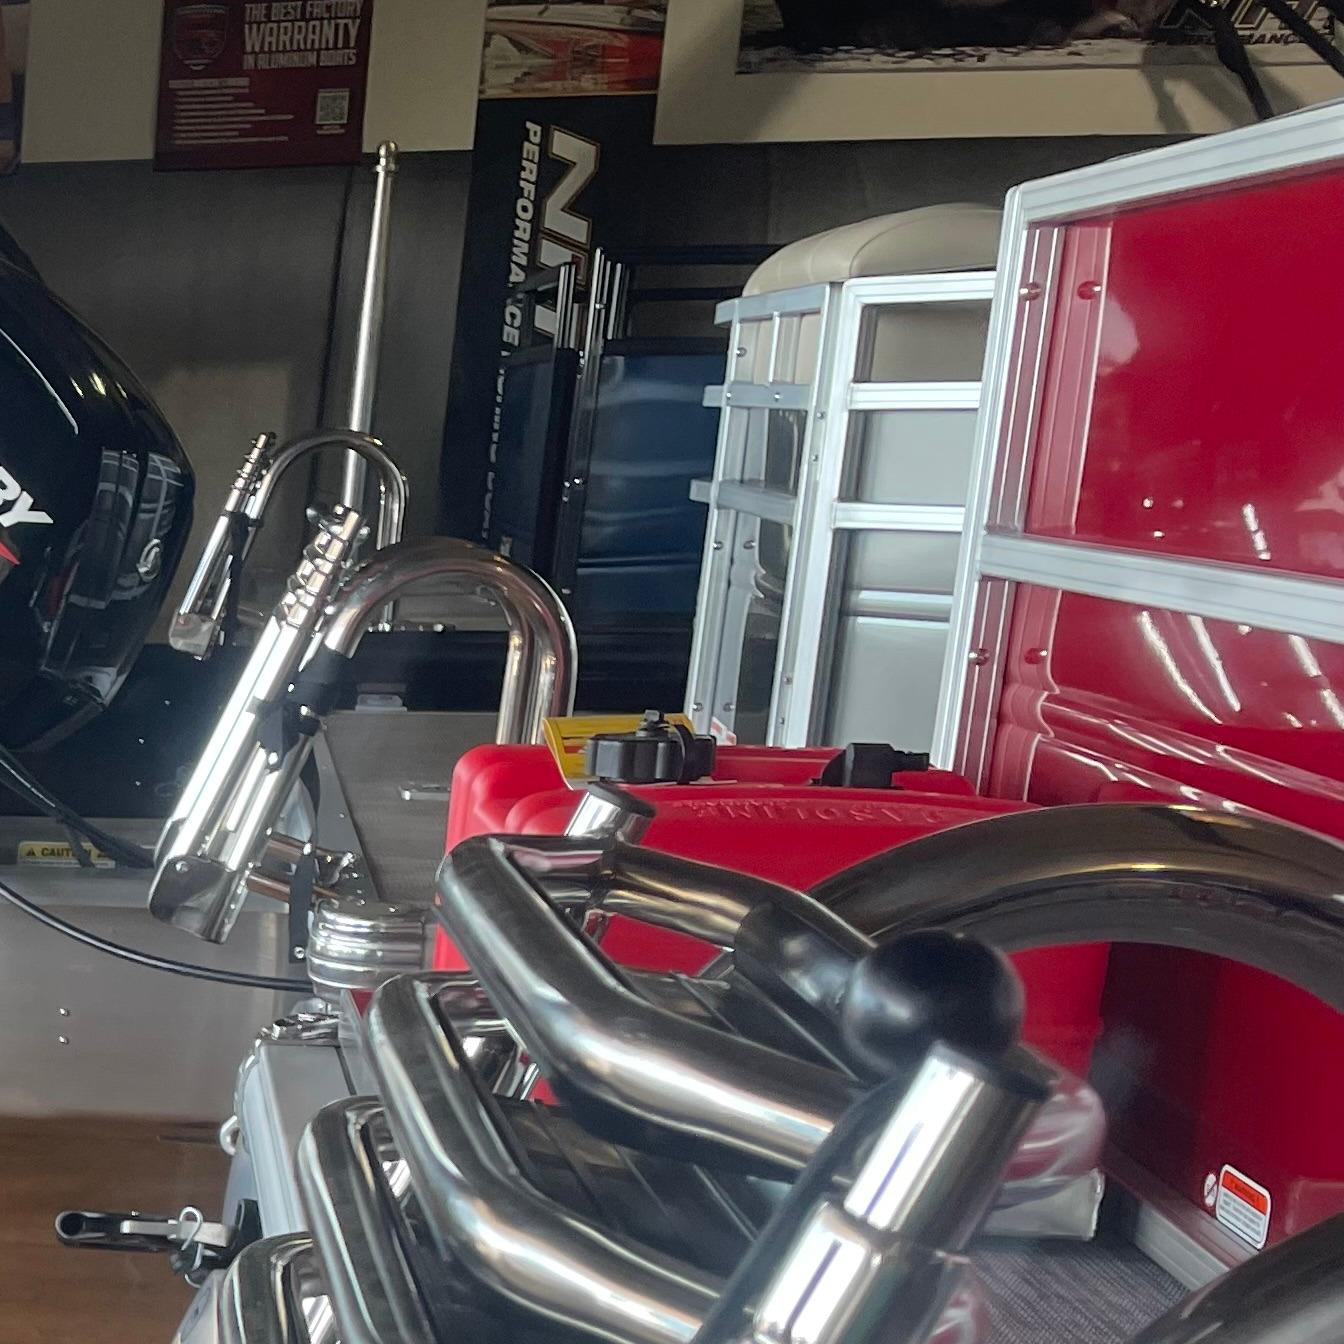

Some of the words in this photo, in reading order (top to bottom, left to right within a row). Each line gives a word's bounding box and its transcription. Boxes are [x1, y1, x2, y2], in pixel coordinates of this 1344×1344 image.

[245, 3, 270, 22] THE
[270, 2, 303, 21] BEST
[305, 1, 362, 19] FACTORY
[244, 19, 361, 53] WARRANTY
[243, 53, 256, 70] IN
